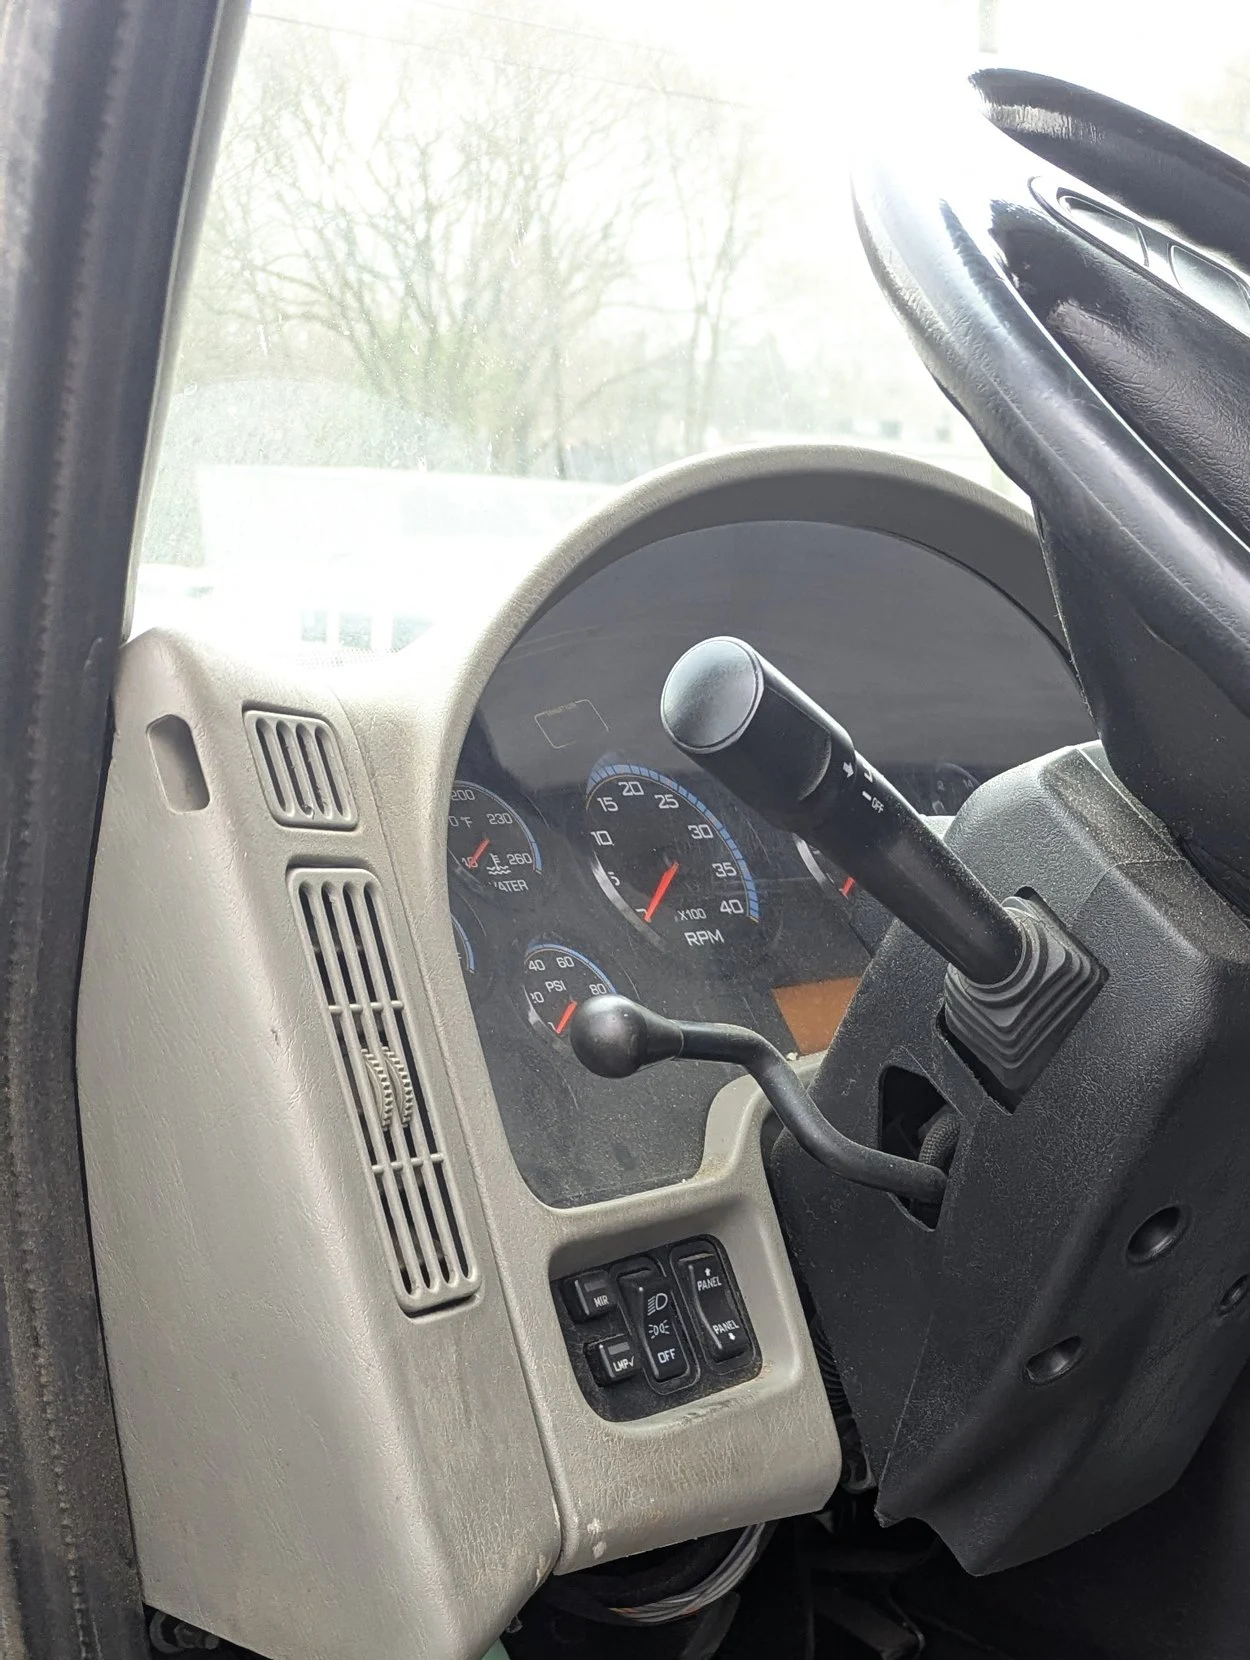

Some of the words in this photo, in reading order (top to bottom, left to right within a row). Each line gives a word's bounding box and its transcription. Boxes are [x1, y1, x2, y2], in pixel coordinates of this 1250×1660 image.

[618, 781, 645, 797] 20
[597, 797, 619, 812] 15
[654, 794, 680, 809] 25
[872, 797, 884, 813] OFF
[486, 813, 513, 825] 230
[591, 831, 614, 847] 10
[688, 824, 714, 839] 30
[506, 852, 533, 865] 260
[712, 862, 737, 878] 35
[488, 879, 529, 893] ATER
[719, 899, 744, 915] 40
[676, 908, 707, 922] X100
[684, 928, 725, 947] RPM
[528, 959, 546, 972] 40
[556, 956, 575, 969] 60
[545, 980, 567, 993] PSI
[589, 982, 607, 996] 80
[697, 1277, 722, 1291] PANEL
[593, 1294, 610, 1309] MIR
[713, 1320, 739, 1334] PANEL
[657, 1348, 676, 1364] OFF
